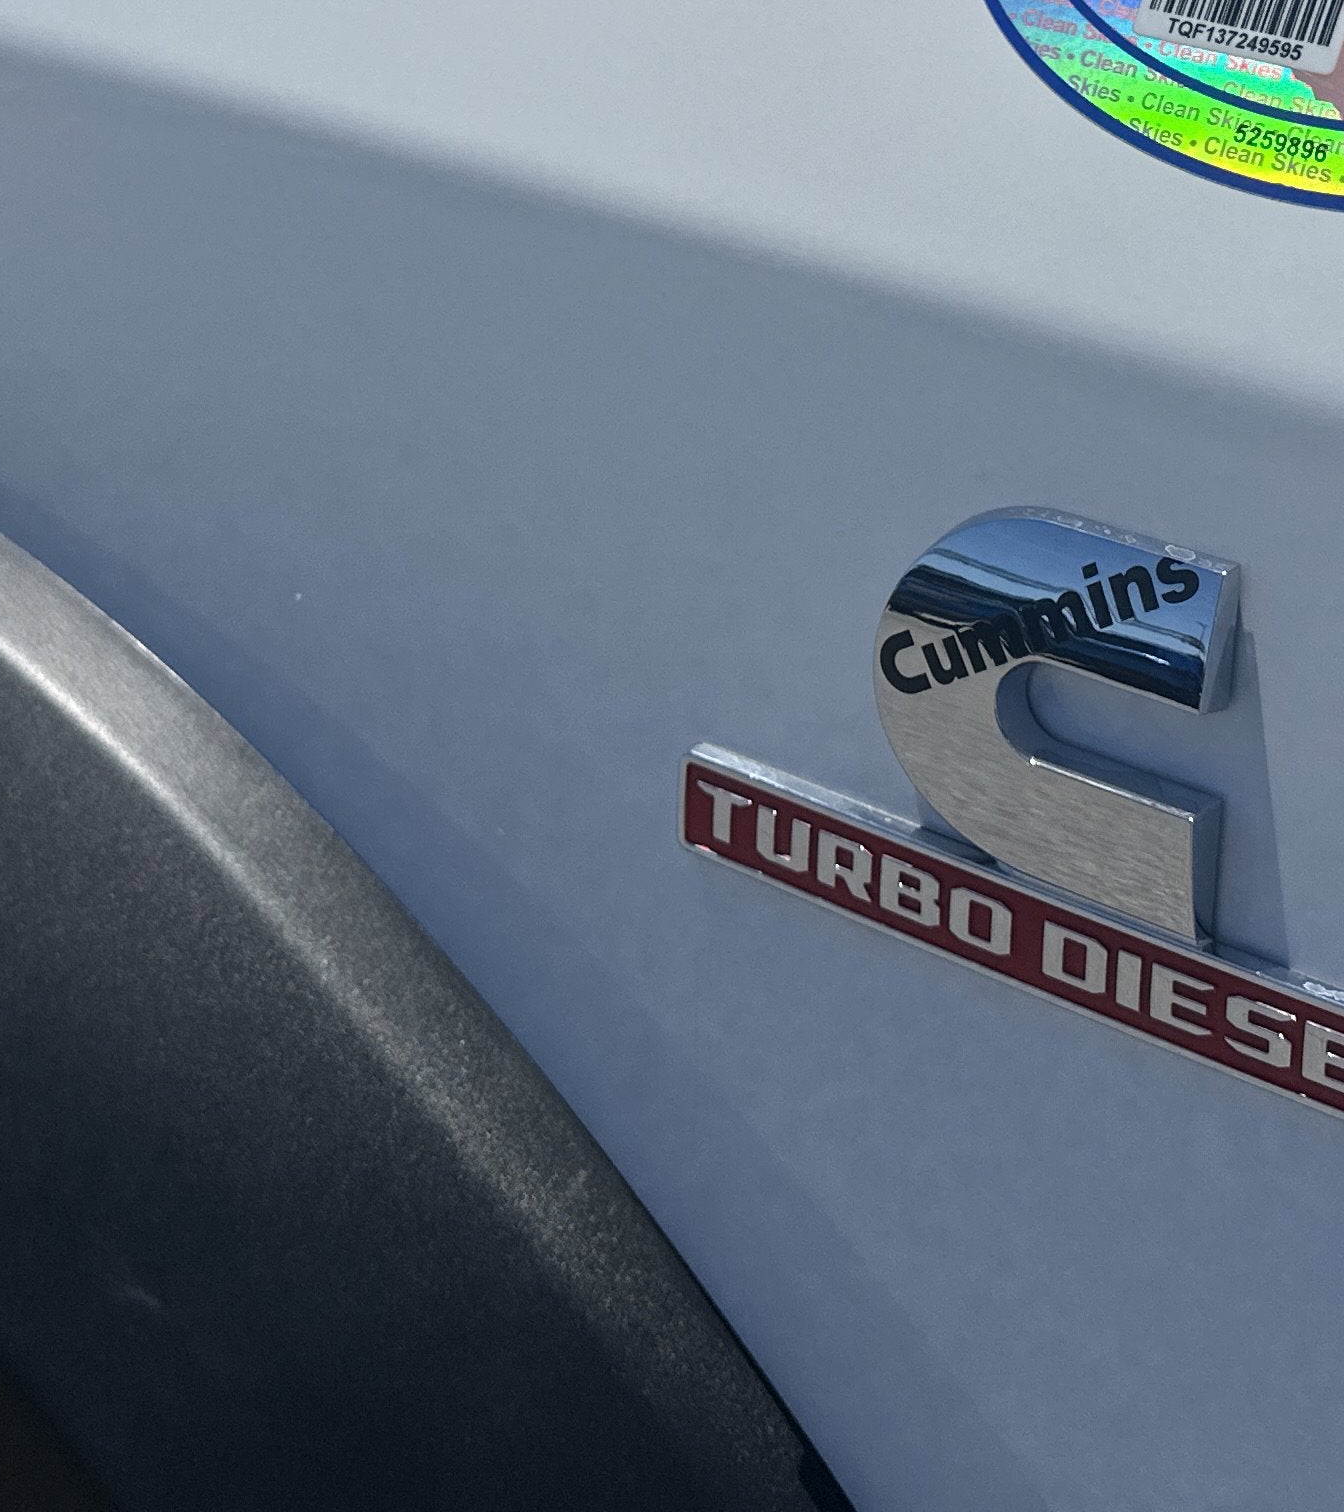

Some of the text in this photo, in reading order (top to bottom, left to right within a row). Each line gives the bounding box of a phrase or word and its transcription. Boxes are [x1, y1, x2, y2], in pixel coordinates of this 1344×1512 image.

[1167, 17, 1303, 62] TQF137249595
[1080, 50, 1137, 76] Clean
[1141, 92, 1202, 121] Clean
[1203, 136, 1265, 166] Clean
[1271, 152, 1333, 182] Skies
[1233, 122, 1330, 163] 5259896
[879, 552, 1202, 695] Cummins
[696, 779, 1013, 957] TURBO
